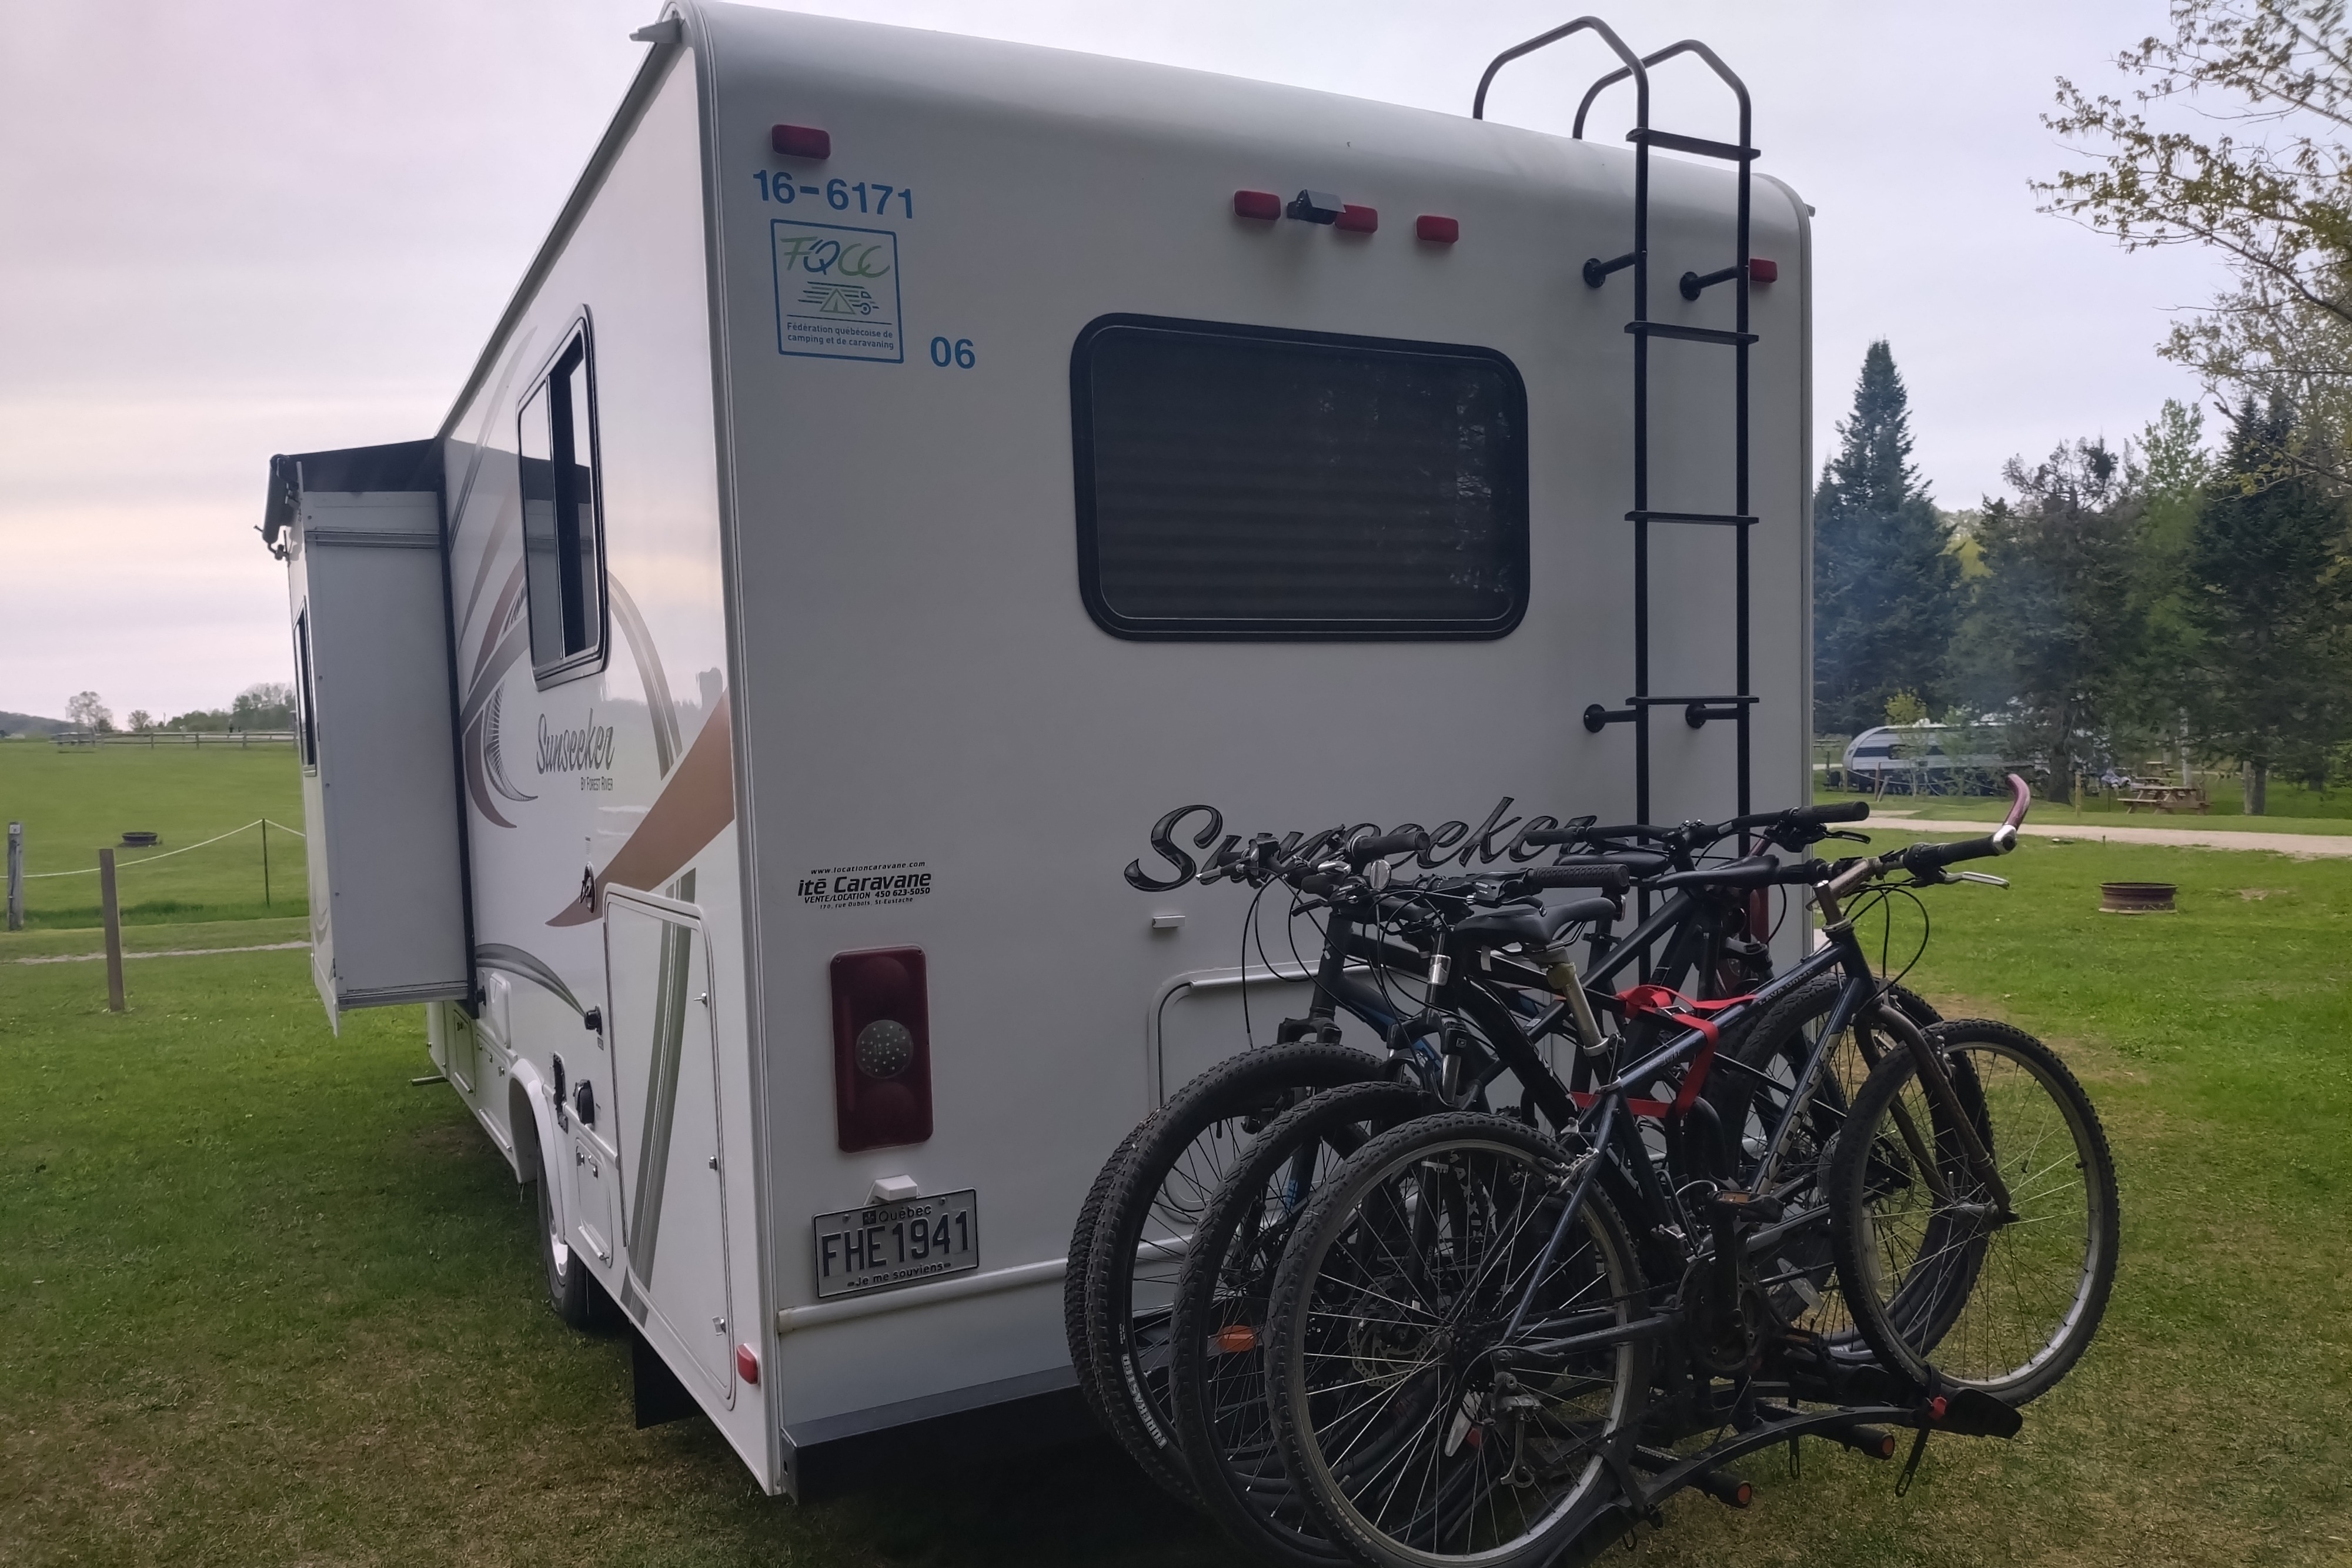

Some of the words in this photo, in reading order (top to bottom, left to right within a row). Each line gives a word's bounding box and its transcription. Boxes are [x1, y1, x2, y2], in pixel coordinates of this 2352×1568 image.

[753, 169, 913, 219] 16-6171
[780, 235, 891, 279] FQCC
[787, 322, 833, 333] Fédération
[835, 326, 881, 337] québécoise
[883, 330, 893, 339] de
[787, 335, 824, 345] camping
[848, 339, 894, 350] caravaning
[930, 336, 975, 369] 06
[536, 707, 615, 775] Sunseeker
[811, 861, 926, 875] www.locationcaravane.com
[834, 873, 931, 894] Caravane
[804, 891, 871, 904] VENTE/LOCATION
[875, 890, 891, 898] 450
[893, 887, 930, 897] 623-5050
[1758, 987, 1785, 1006] LAVA
[877, 1204, 933, 1223] Québec
[821, 1209, 970, 1278] FHE1941
[855, 1276, 869, 1286] Je
[873, 1273, 890, 1283] me
[893, 1262, 944, 1279] souviens
[1331, 1496, 1372, 1543] KENDA
